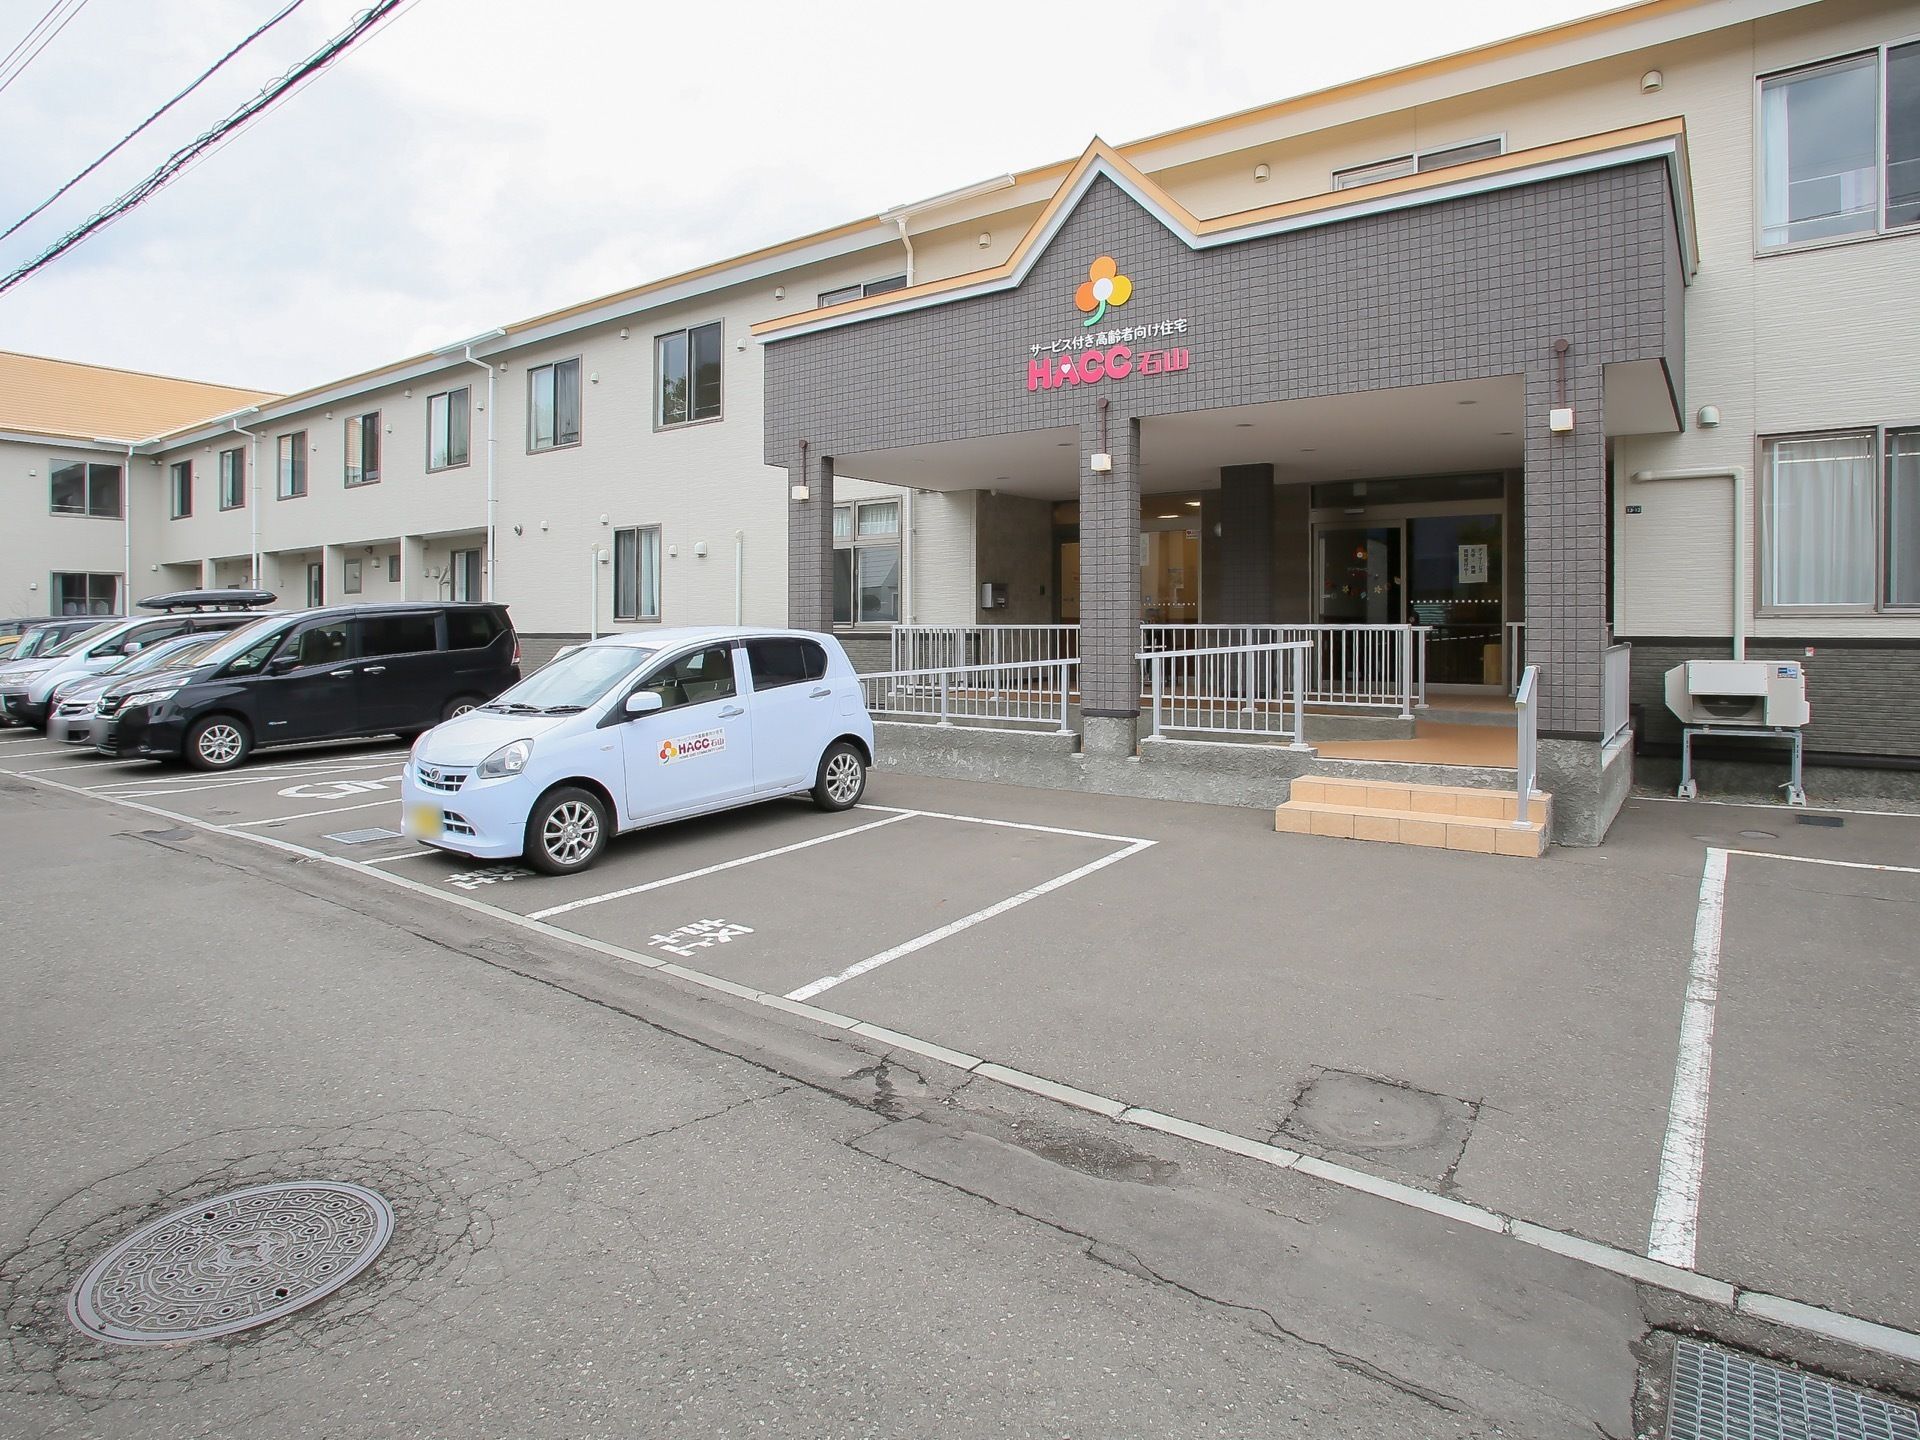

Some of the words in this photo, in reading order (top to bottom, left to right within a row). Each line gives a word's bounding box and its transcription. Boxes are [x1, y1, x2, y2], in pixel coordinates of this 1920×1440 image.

[1030, 318, 1188, 357] サービス付き高齢者向け住宅
[1027, 344, 1133, 391] HACC
[1137, 348, 1190, 376] 石山
[678, 738, 710, 754] HACC
[711, 738, 725, 747] 石山
